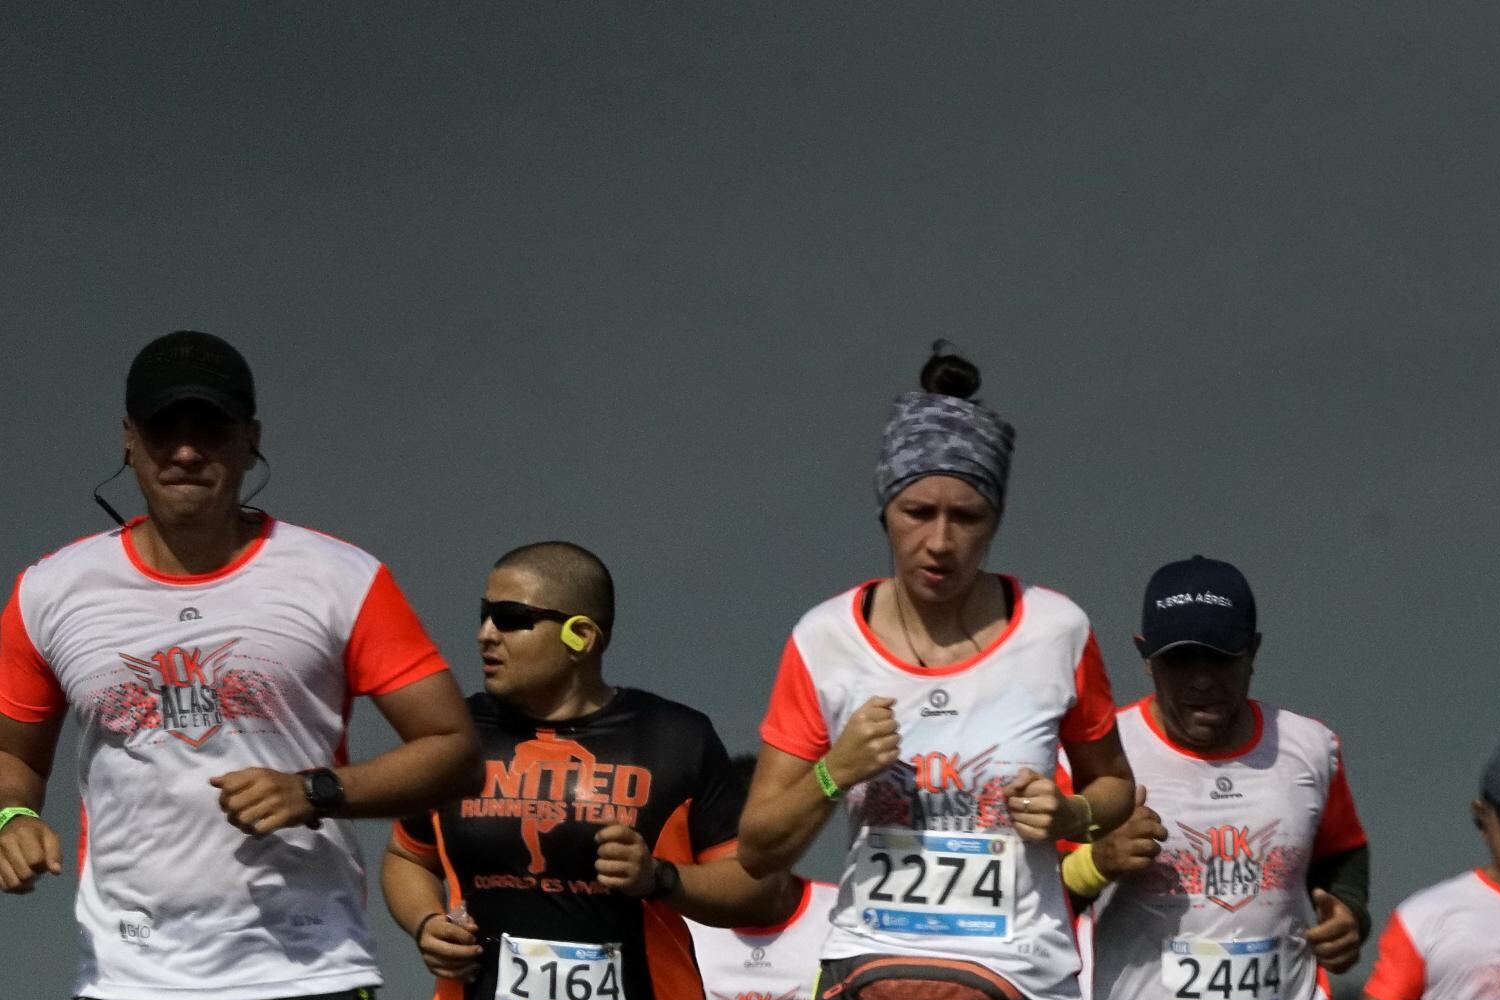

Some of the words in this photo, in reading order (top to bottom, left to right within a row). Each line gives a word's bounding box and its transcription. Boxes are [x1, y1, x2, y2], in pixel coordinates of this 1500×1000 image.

[152, 647, 207, 688] 10K
[480, 759, 652, 807] NITED
[911, 752, 964, 793] 10K
[461, 799, 568, 820] RUNNERS
[573, 803, 638, 828] TEAM
[1208, 825, 1254, 861] 10K
[869, 852, 1003, 907] 2274
[1175, 954, 1280, 1000] 2444
